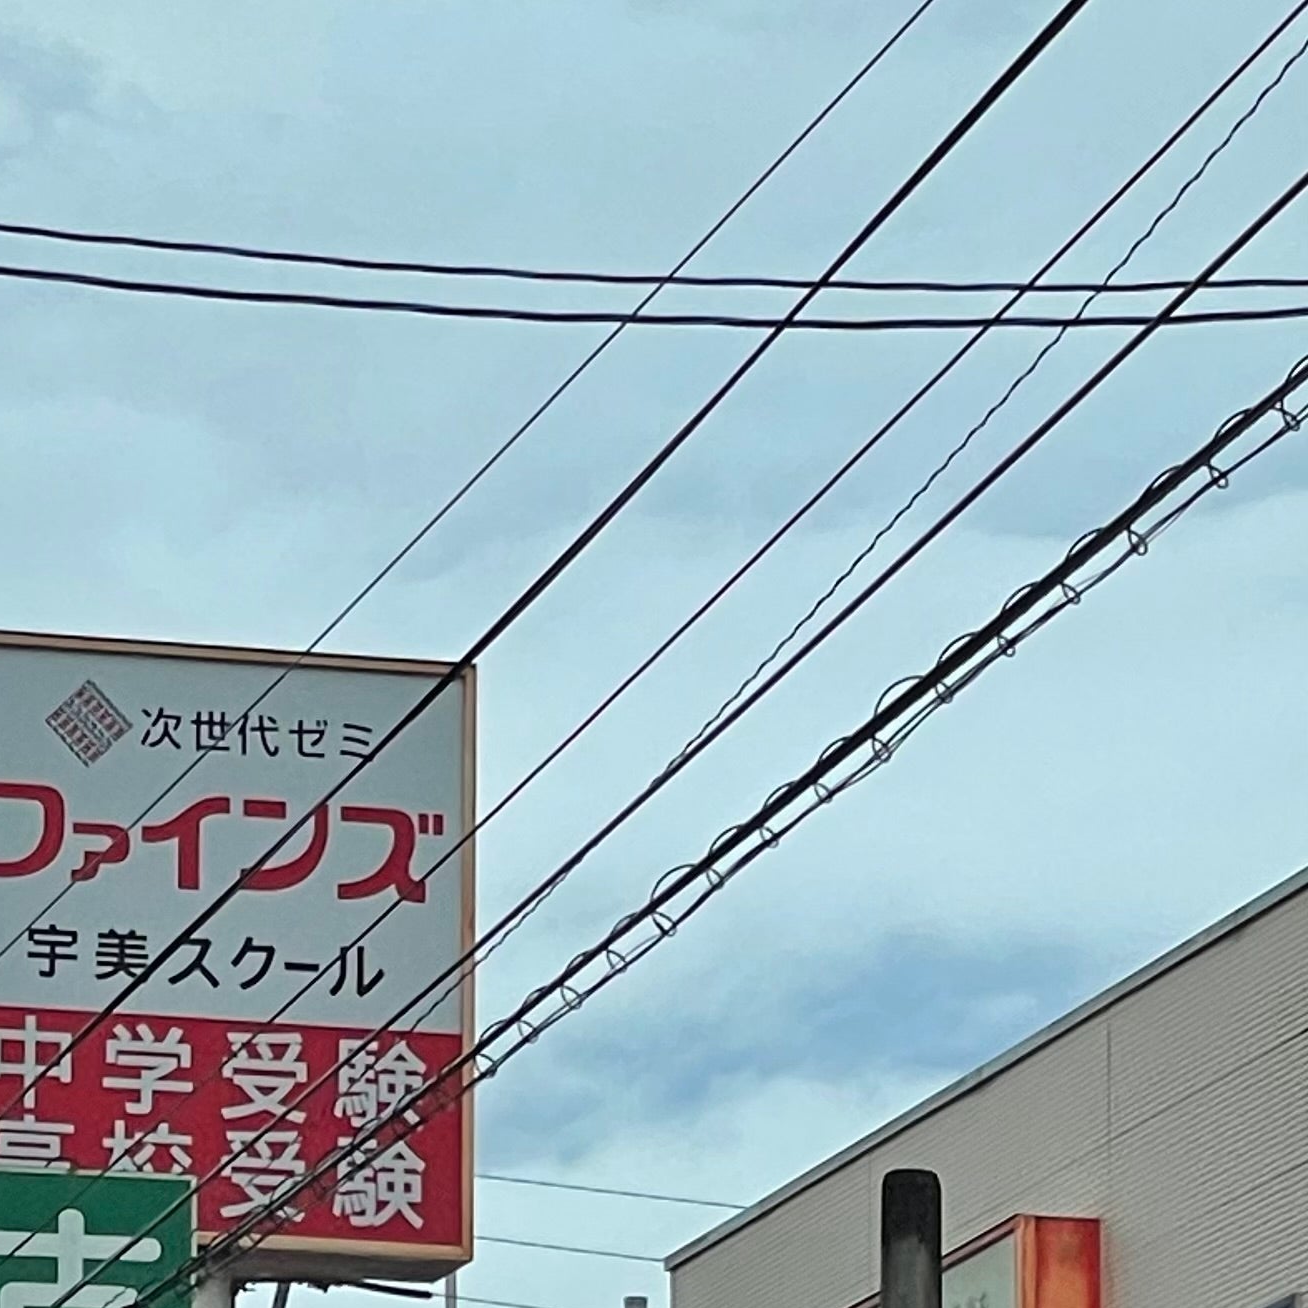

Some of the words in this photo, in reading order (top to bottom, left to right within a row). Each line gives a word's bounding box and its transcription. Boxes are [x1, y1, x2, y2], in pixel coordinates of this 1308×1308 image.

[140, 706, 376, 761] 次世代ゼミ
[27, 923, 386, 998] 宇美スクール
